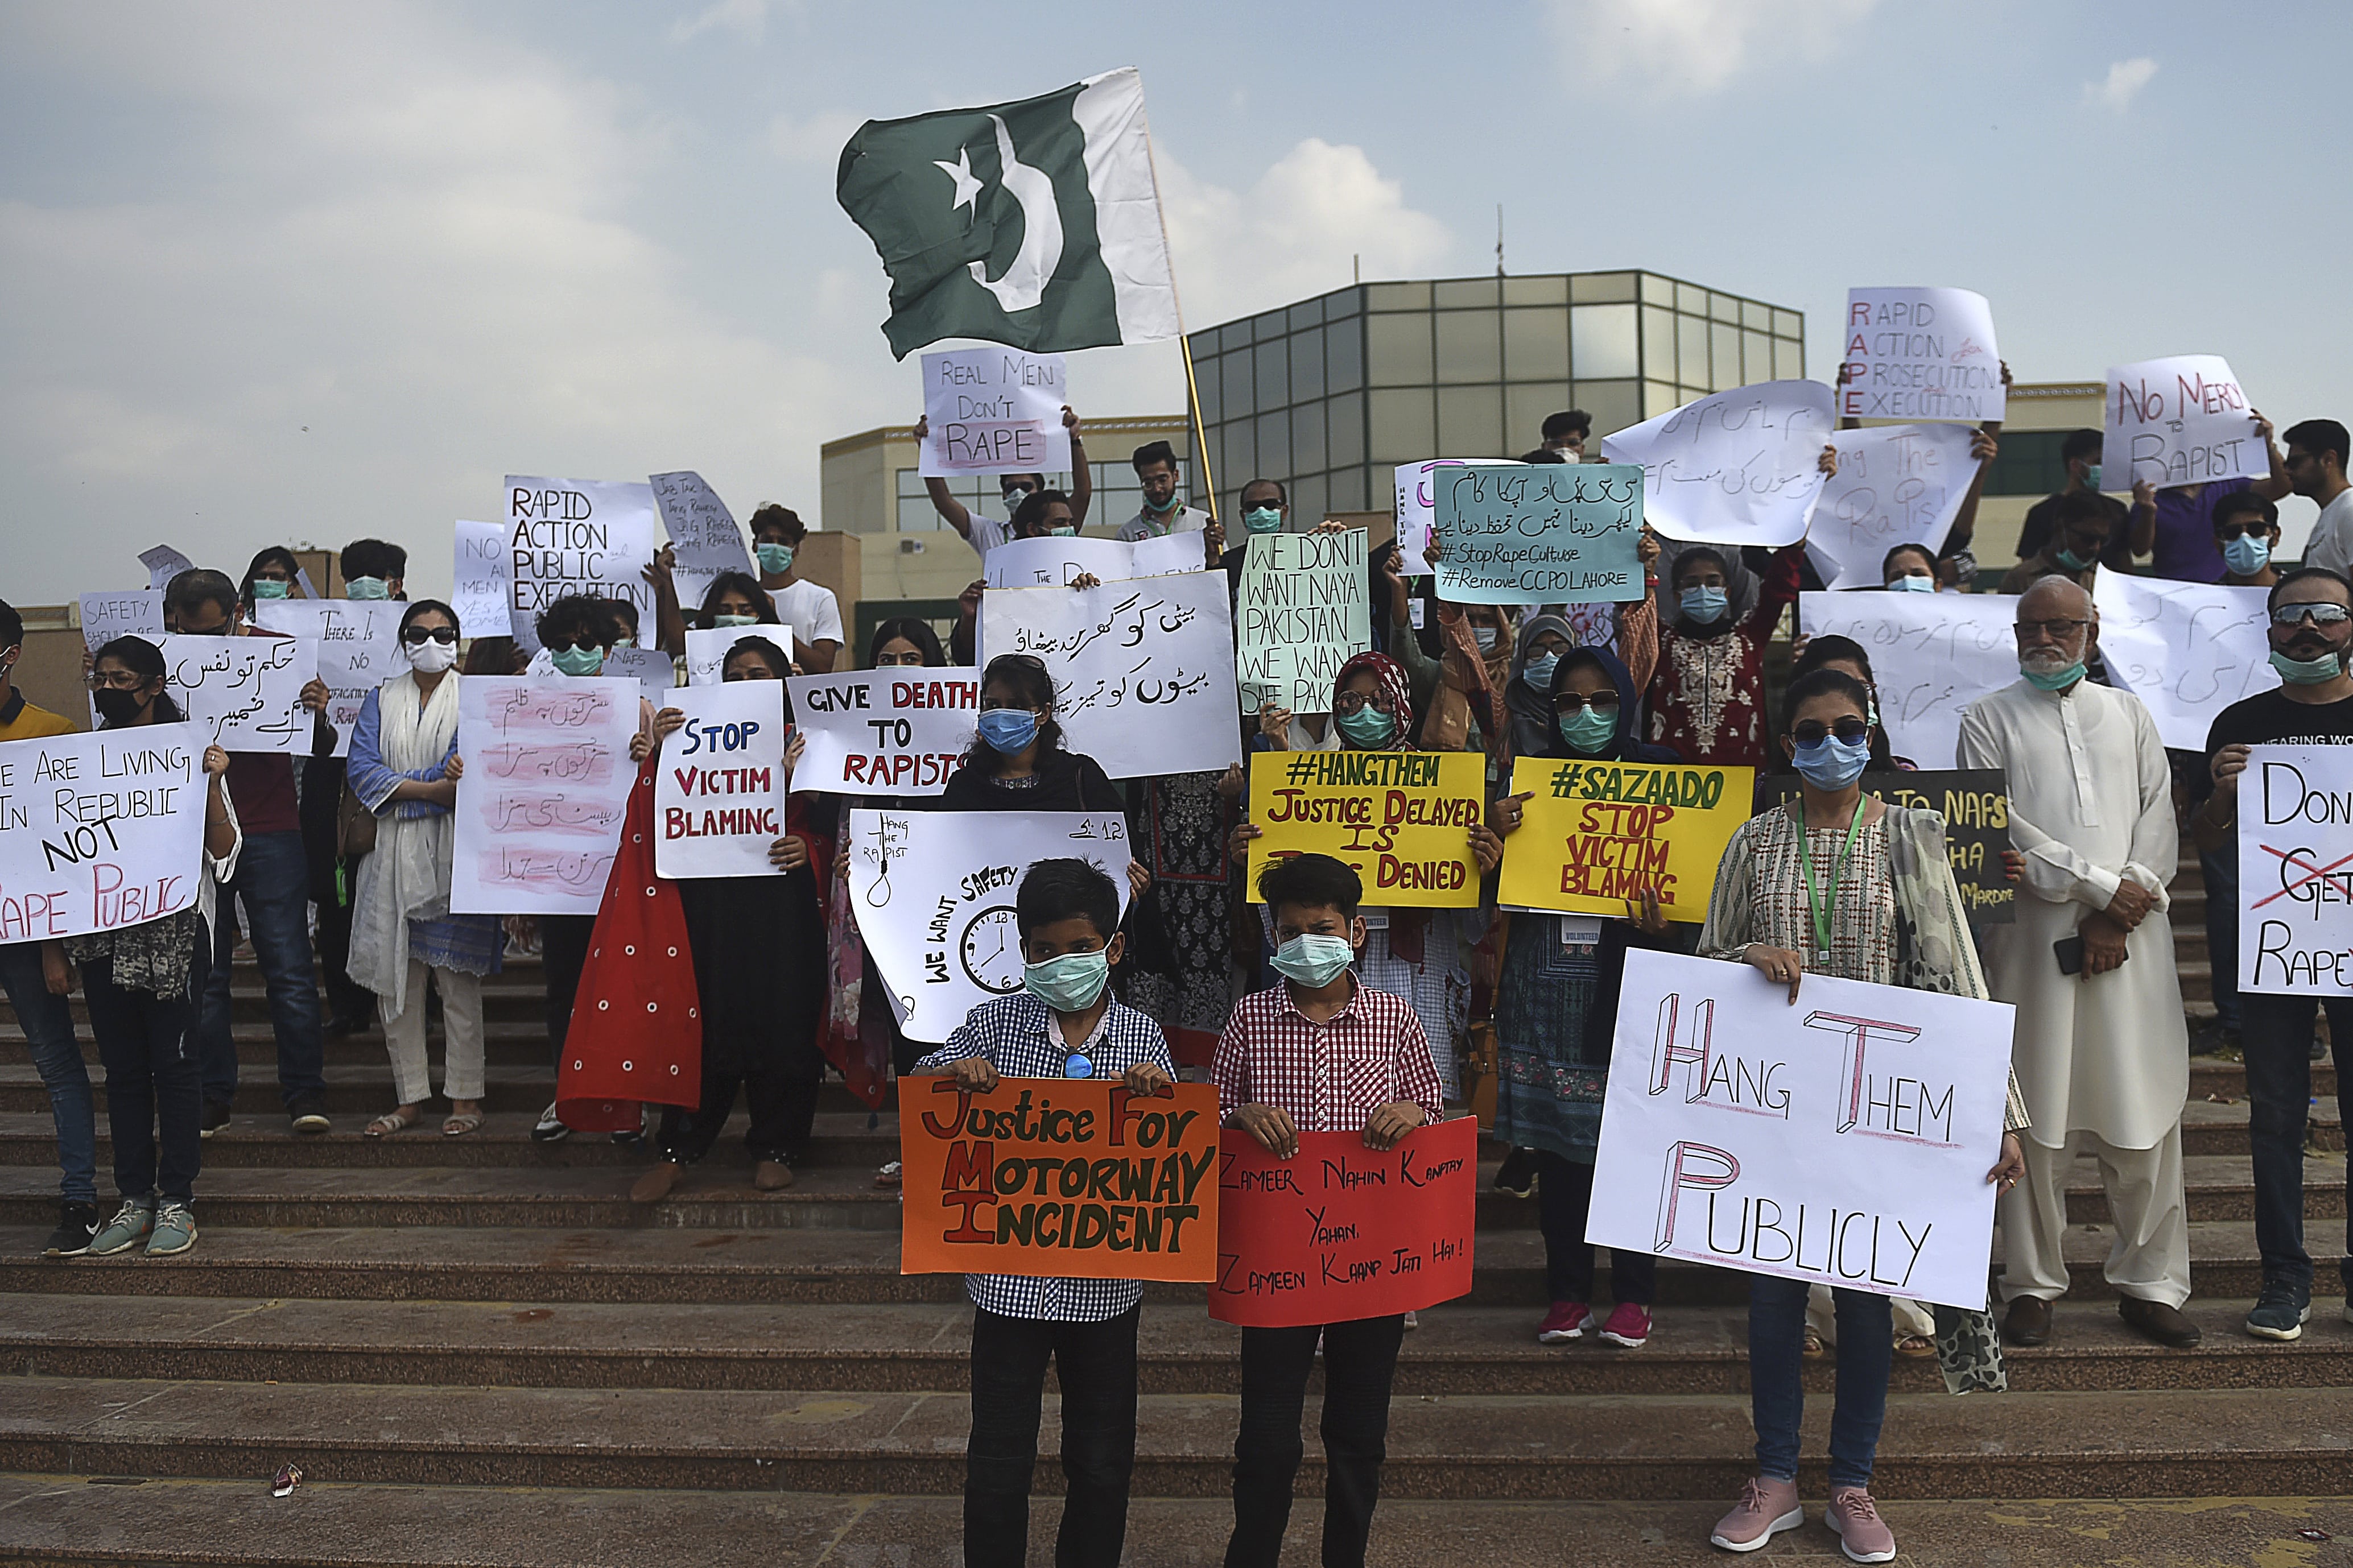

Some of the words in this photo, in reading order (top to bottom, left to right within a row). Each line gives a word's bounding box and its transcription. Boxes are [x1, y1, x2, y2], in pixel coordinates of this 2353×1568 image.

[942, 360, 988, 385] REAL
[1002, 355, 1054, 386] MEN
[958, 394, 1014, 420] DON'T
[2119, 378, 2164, 426] NO
[2178, 373, 2244, 419] MERCY
[946, 423, 1034, 461] RAPE
[2131, 433, 2245, 485] RAPIST
[513, 487, 592, 520] RAPID
[512, 520, 607, 549] ACTION
[1252, 535, 1285, 570] WE
[1298, 529, 1365, 570] DON'T
[513, 550, 604, 580] PUBLIC
[1033, 570, 1051, 584] THE
[1246, 573, 1302, 606] WANT
[1310, 573, 1360, 605] NAYA
[85, 601, 149, 626] SAFETY
[320, 610, 354, 640] THERE
[1247, 606, 1348, 646] PAKISTAN
[349, 652, 369, 670] NO
[1242, 647, 1281, 680] WE
[807, 684, 870, 712] GIVE
[891, 681, 978, 709] DEATH
[682, 718, 759, 755] STOP
[868, 718, 912, 748] TO
[34, 750, 79, 784] ARE
[101, 744, 191, 784] LIVING
[674, 765, 770, 797] VICTIM
[1286, 754, 1441, 787] #HANGTHEM
[1550, 763, 1724, 809] #SAZAADO
[55, 788, 179, 824] REPUBLIC
[666, 807, 779, 840] BLAMING
[1268, 789, 1373, 824] JUSTICE
[1384, 789, 1480, 827] DELAYED
[1578, 802, 1675, 839] STOP
[1945, 789, 2008, 829] NAFS
[42, 814, 119, 871] NOT
[1102, 821, 1125, 841] 12
[1340, 824, 1400, 852] IS
[1377, 854, 1466, 890] DENIED
[1566, 834, 1670, 874] VICTIM
[0, 883, 68, 939] APE
[93, 863, 186, 928] PUBLIC
[961, 865, 1018, 902] SAFETY
[1561, 864, 1678, 905] BLAMING
[926, 895, 957, 943] WANT
[926, 950, 951, 984] WE
[1001, 976, 1011, 988] 6
[1649, 993, 1790, 1120] HANG
[1803, 1010, 1954, 1142] THEM
[921, 1080, 1095, 1143] Justice
[1109, 1085, 1200, 1149] For
[941, 1140, 1216, 1205] MOTORWAY
[1219, 1152, 1304, 1195] ZAMEER
[1321, 1156, 1386, 1192] NAHIN
[942, 1190, 1199, 1253] INCIDENT
[1654, 1141, 1932, 1288] PUBLICLY
[1219, 1253, 1305, 1296] ZAMEEN
[1321, 1252, 1382, 1286] KAANP
